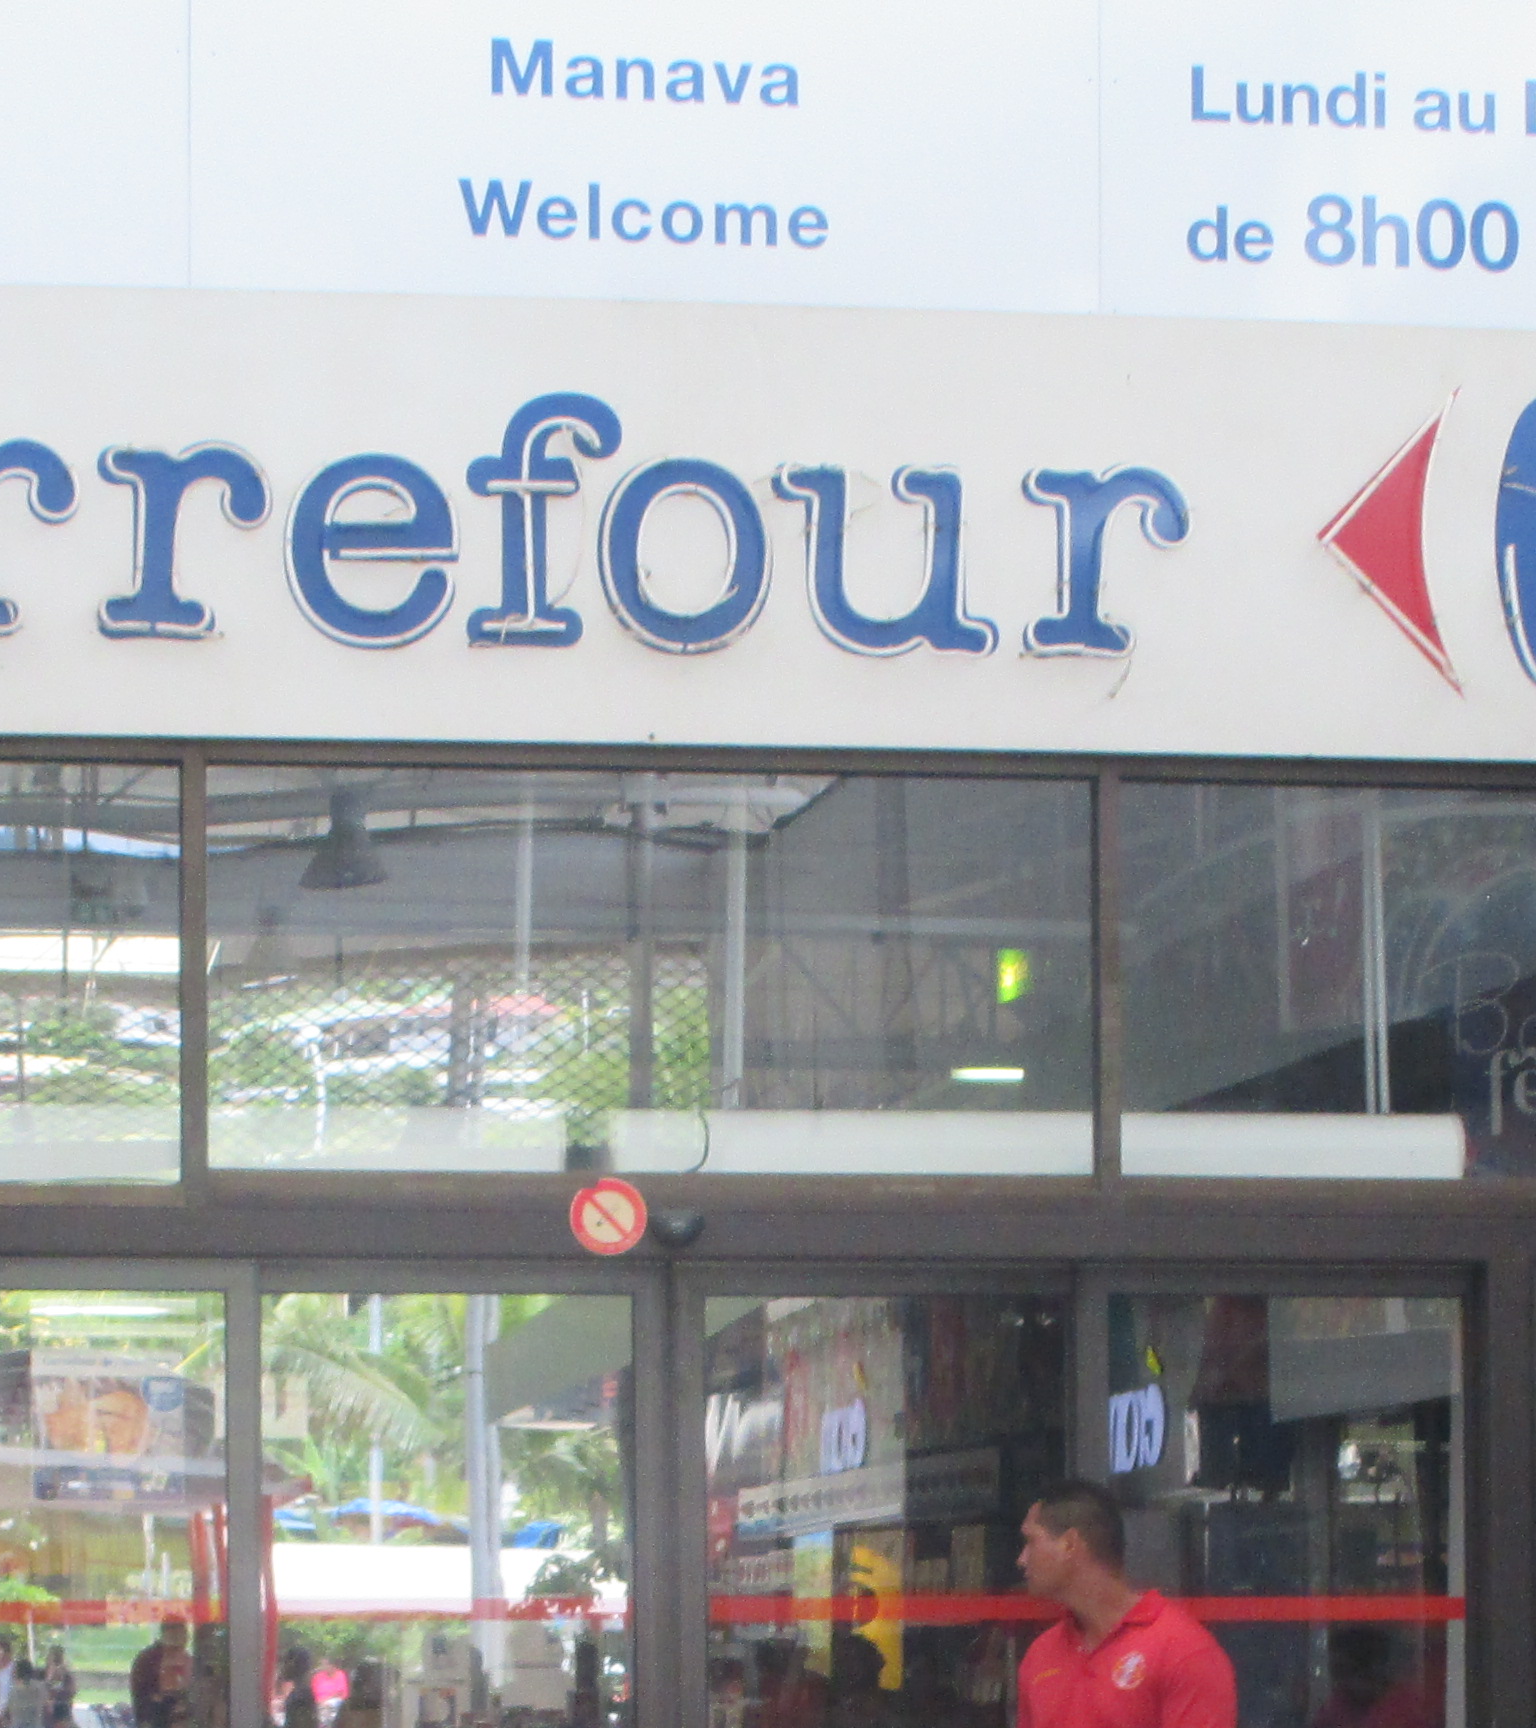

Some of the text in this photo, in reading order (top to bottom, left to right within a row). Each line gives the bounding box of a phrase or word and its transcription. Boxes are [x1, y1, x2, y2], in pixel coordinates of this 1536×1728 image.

[489, 36, 801, 106] Manava
[1190, 64, 1388, 130] Lundi
[1413, 87, 1498, 134] au
[457, 176, 831, 250] Welcome
[1186, 203, 1276, 264] de
[1303, 192, 1522, 274] 8h00
